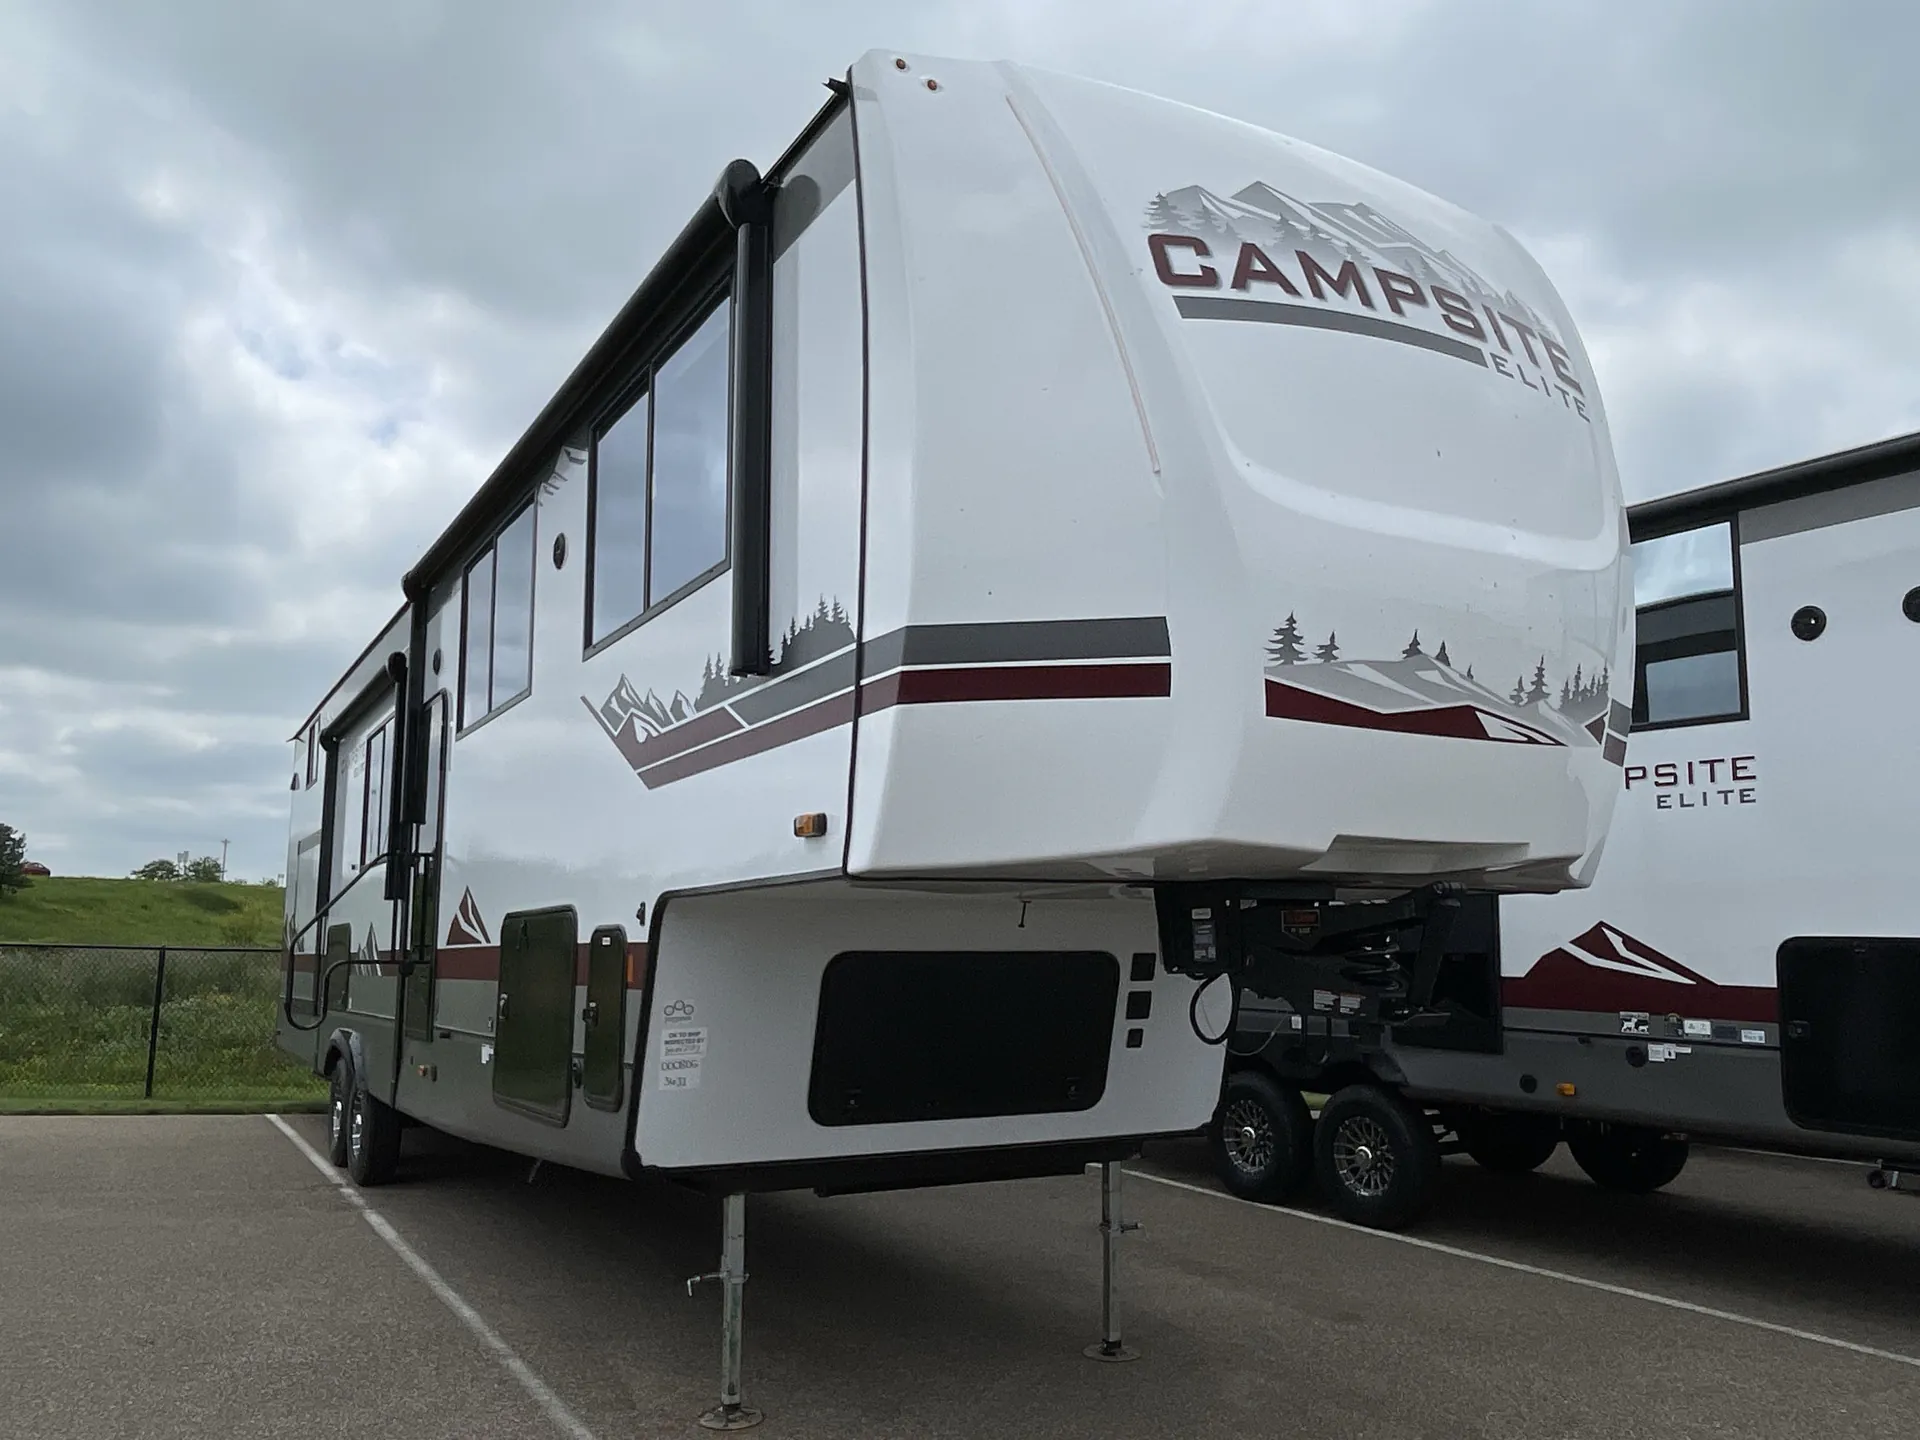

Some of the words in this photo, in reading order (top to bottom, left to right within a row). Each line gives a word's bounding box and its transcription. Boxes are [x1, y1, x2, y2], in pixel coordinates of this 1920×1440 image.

[1148, 233, 1584, 394] CAMPSITE
[1490, 352, 1591, 423] ELITE
[1624, 756, 1757, 790] PSITE
[1656, 788, 1757, 809] ELITE
